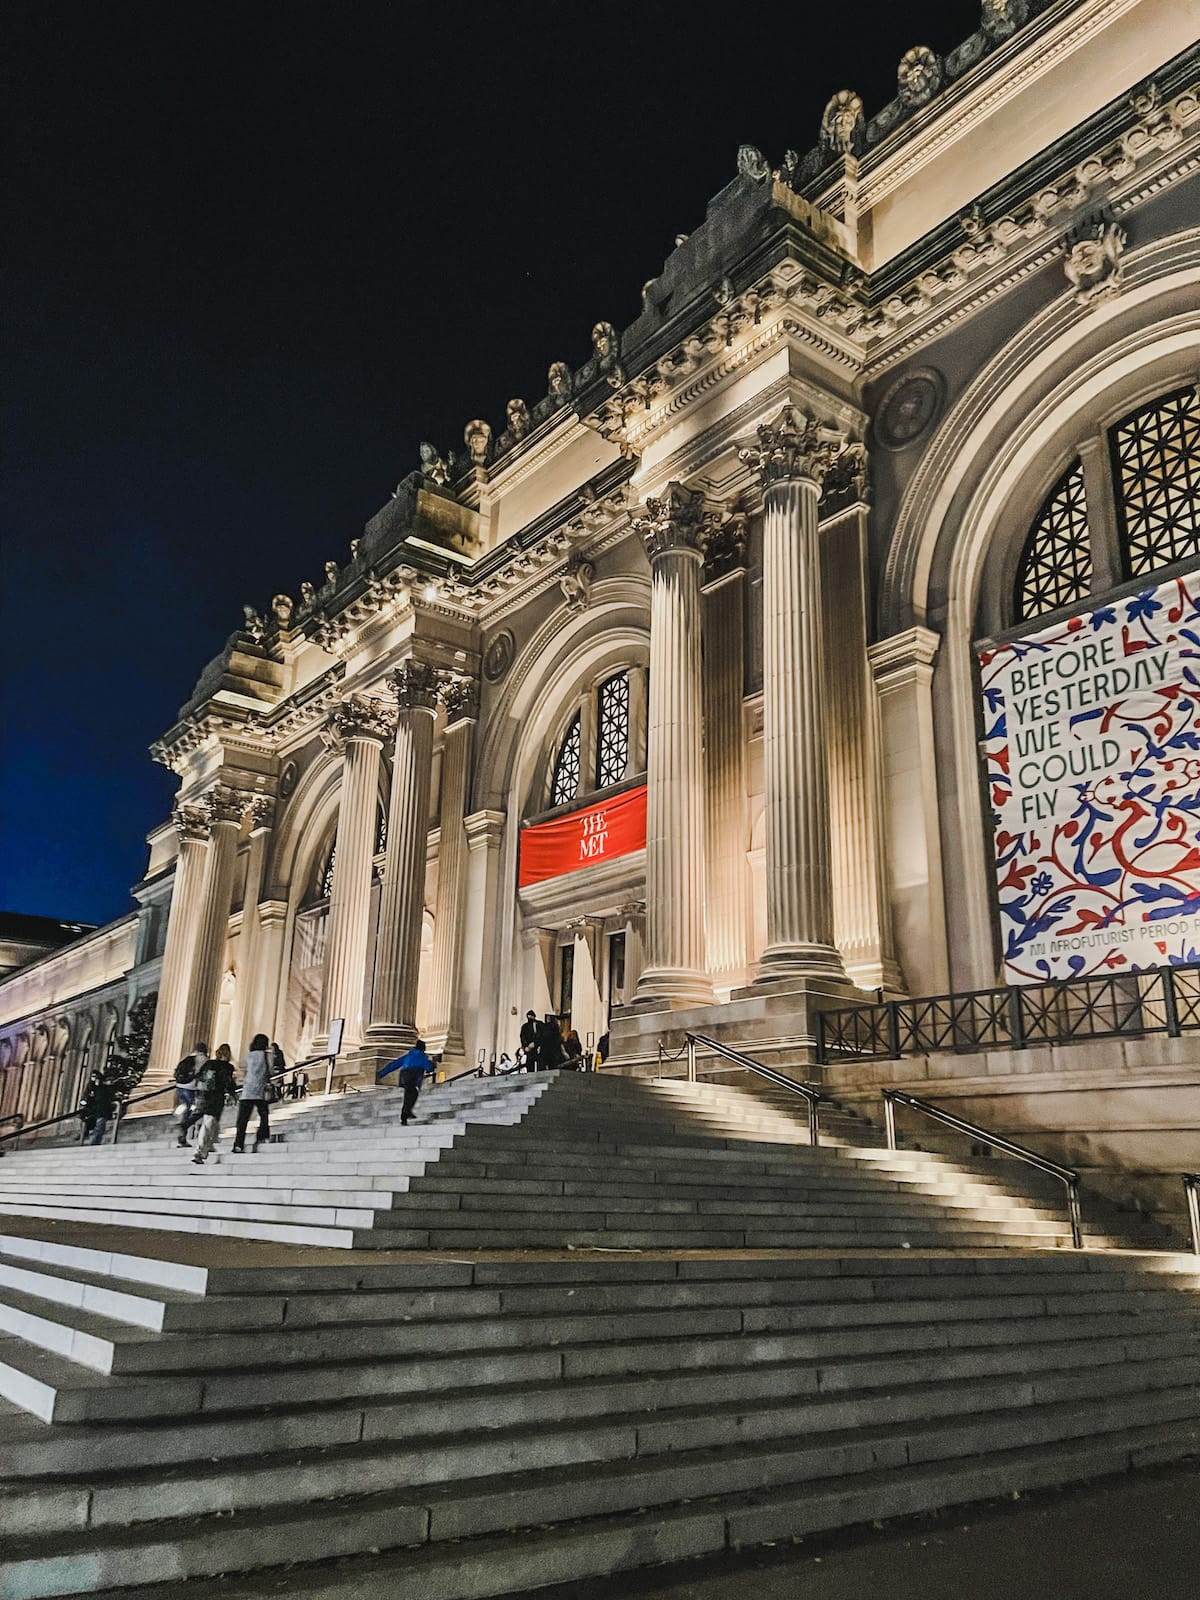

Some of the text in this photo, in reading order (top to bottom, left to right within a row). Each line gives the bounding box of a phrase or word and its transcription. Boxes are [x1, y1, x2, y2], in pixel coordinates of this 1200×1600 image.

[1011, 636, 1116, 696] BEFORE
[1013, 651, 1169, 725] YESTERDAY
[1016, 721, 1061, 757] WE
[1018, 739, 1120, 788] COULD
[1021, 788, 1059, 823] FLY
[580, 811, 608, 837] THE
[579, 831, 608, 860] MET
[1030, 943, 1046, 956] AN
[1050, 928, 1135, 953] AFROFUTURIST
[1140, 921, 1189, 939] PERIOD
